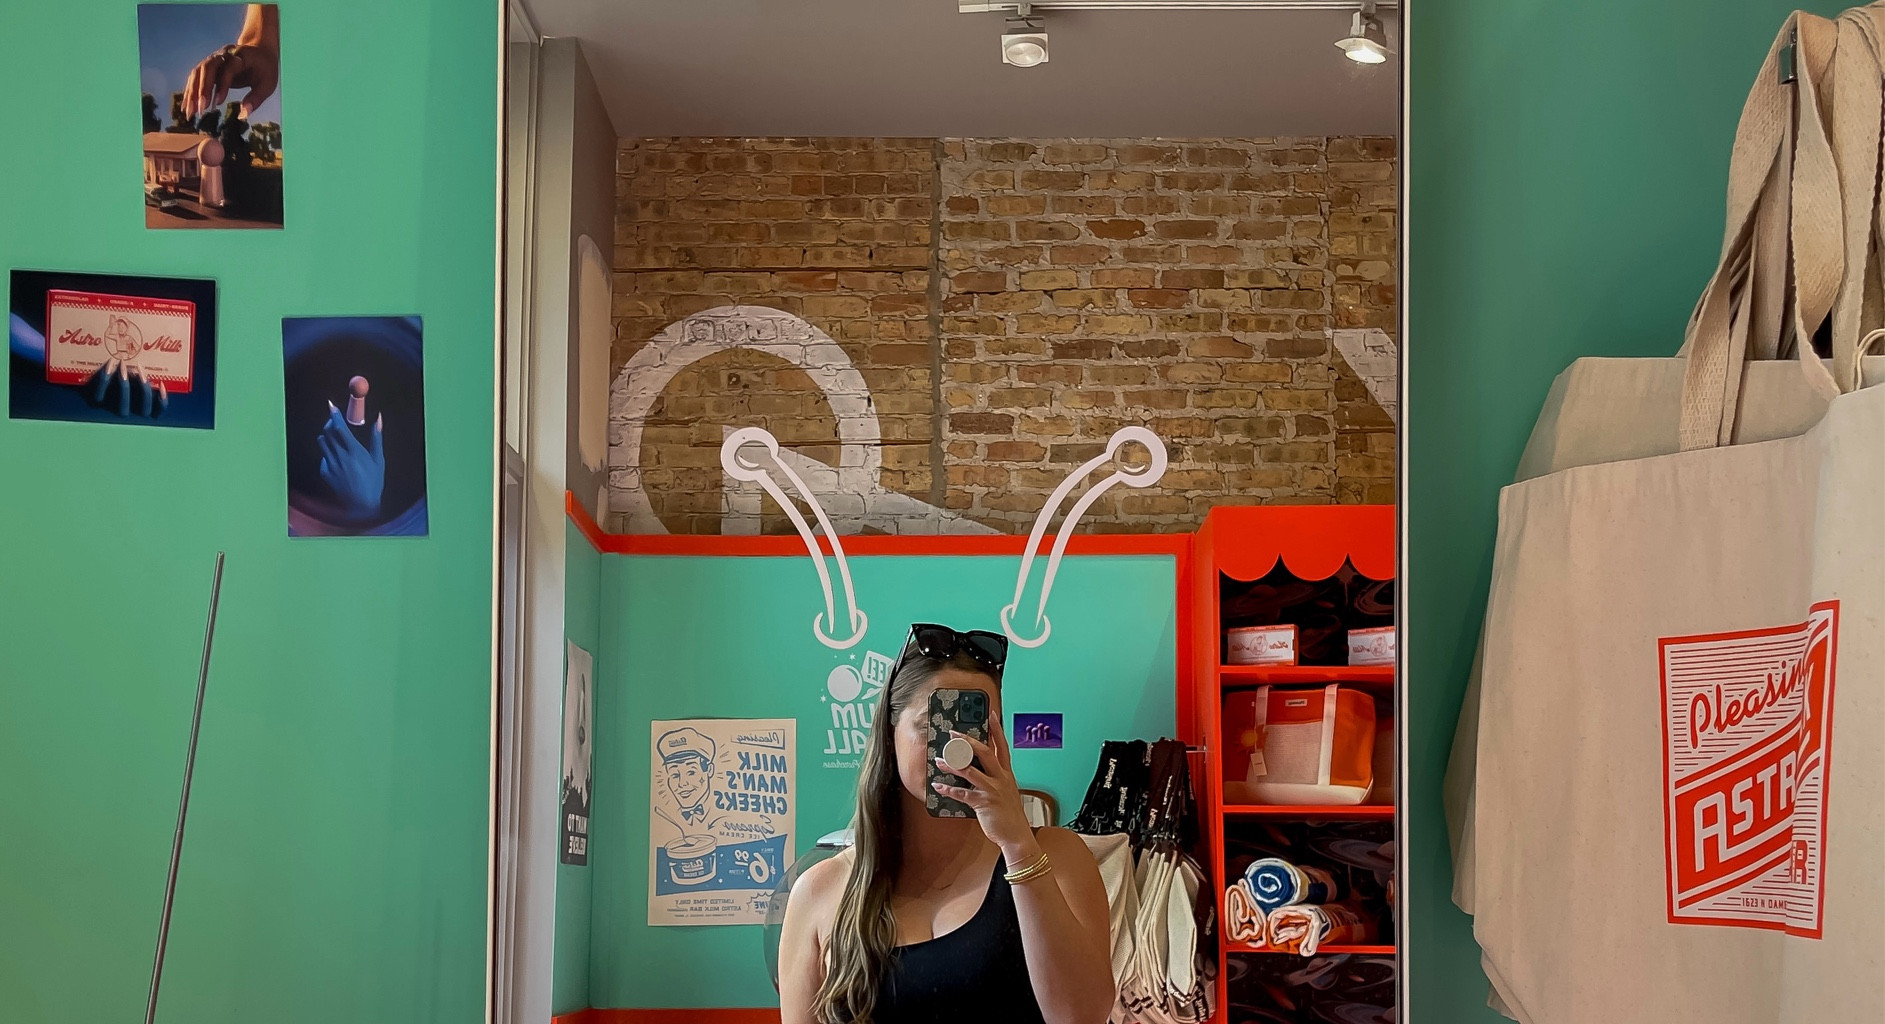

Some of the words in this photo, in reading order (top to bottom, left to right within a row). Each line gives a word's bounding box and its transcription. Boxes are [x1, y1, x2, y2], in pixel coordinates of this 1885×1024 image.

[58, 328, 102, 347] Astro
[143, 335, 182, 353] Milk
[1690, 659, 1804, 750] Pleasin
[1693, 732, 1808, 874] ASTR
[1742, 897, 1758, 908] 1623
[1760, 898, 1766, 908] N
[1768, 898, 1788, 910] DAME
